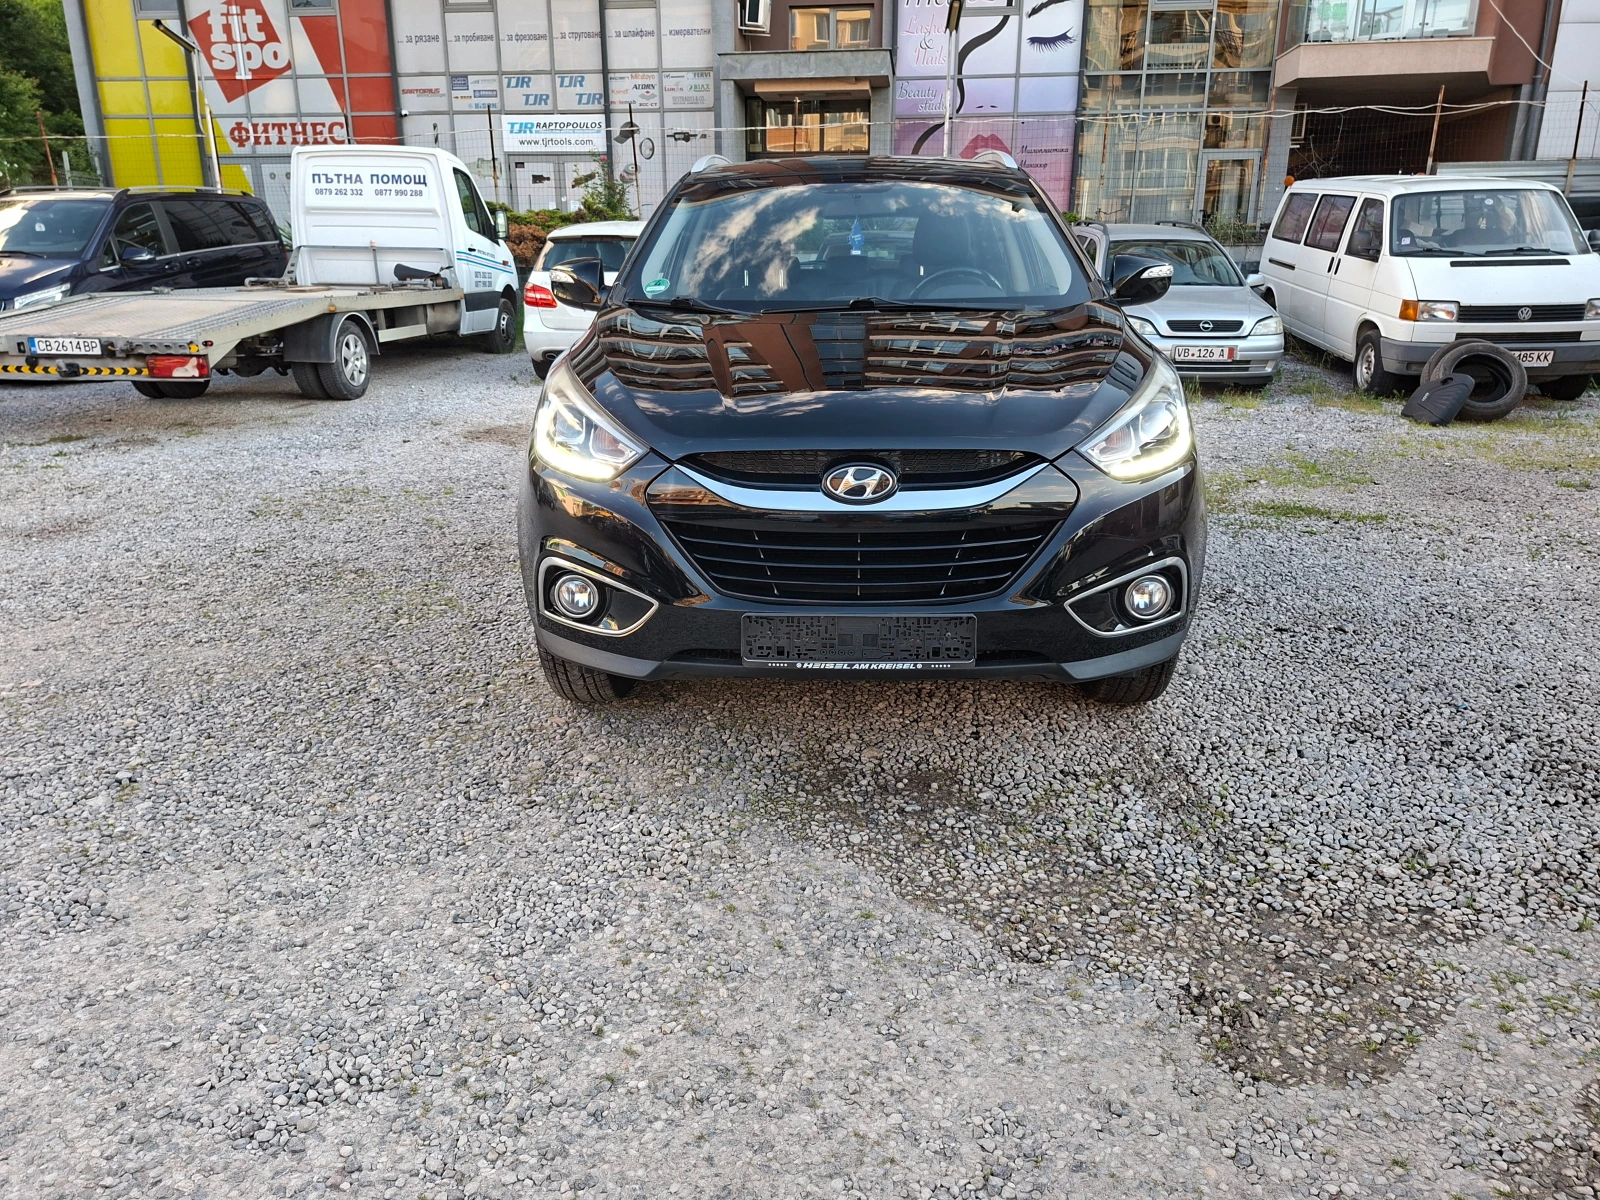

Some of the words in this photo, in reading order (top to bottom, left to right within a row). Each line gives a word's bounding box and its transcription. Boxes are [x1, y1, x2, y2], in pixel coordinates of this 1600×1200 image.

[207, 4, 266, 42] fit
[405, 34, 412, 43] за
[414, 33, 440, 45] рязане
[453, 34, 461, 42] за
[461, 32, 494, 44] пробиване
[506, 33, 514, 42] за
[514, 32, 548, 44] фрезоване
[560, 31, 567, 39] за
[568, 30, 602, 41] струговане
[614, 30, 621, 38] за
[622, 28, 655, 41] шлайфане
[668, 28, 712, 38] измервателни
[920, 33, 934, 50] &
[504, 76, 532, 89] TJR
[557, 75, 585, 88] TJR
[897, 81, 938, 101] Beauty
[522, 93, 550, 106] TJR
[575, 92, 603, 105] TJR
[918, 94, 951, 112] studi
[507, 122, 535, 134] TJR
[536, 121, 602, 129] RAPTOPOULOS
[229, 121, 347, 148] ФИТНЕС
[518, 138, 594, 147] www.tjrtools.com
[312, 173, 364, 185] ПЪТНА
[370, 174, 427, 187] ПОМОЩ
[315, 188, 332, 196] 0879
[334, 188, 348, 196] 262
[350, 188, 363, 196] 332
[395, 189, 408, 197] 990
[410, 189, 423, 197] 288
[54, 340, 82, 353] 2614
[1177, 348, 1190, 358] VB
[1196, 348, 1215, 359] 126
[1218, 348, 1225, 358] A
[1536, 352, 1551, 363] KK
